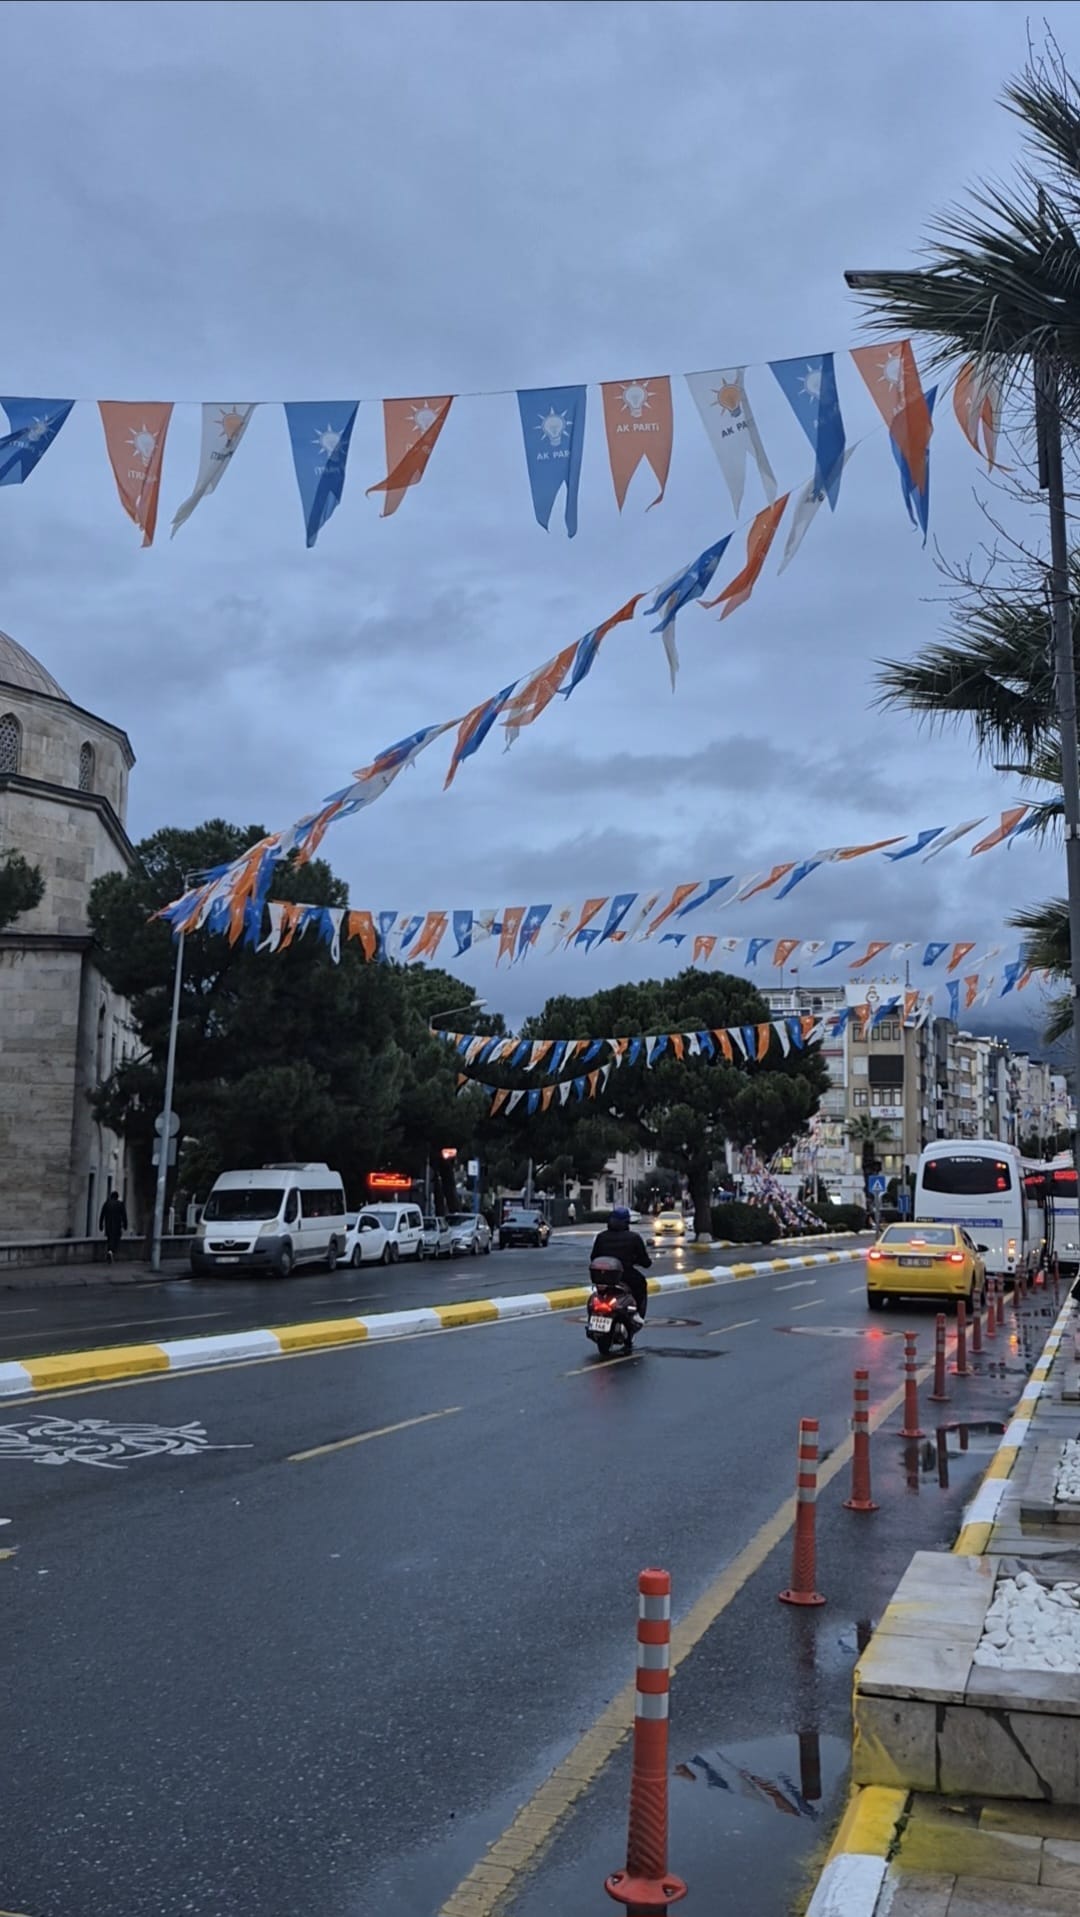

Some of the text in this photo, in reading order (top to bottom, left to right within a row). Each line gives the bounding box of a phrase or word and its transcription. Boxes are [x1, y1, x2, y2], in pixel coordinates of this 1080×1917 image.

[616, 424, 630, 433] AK
[721, 426, 735, 438] AK
[536, 452, 550, 461] AK
